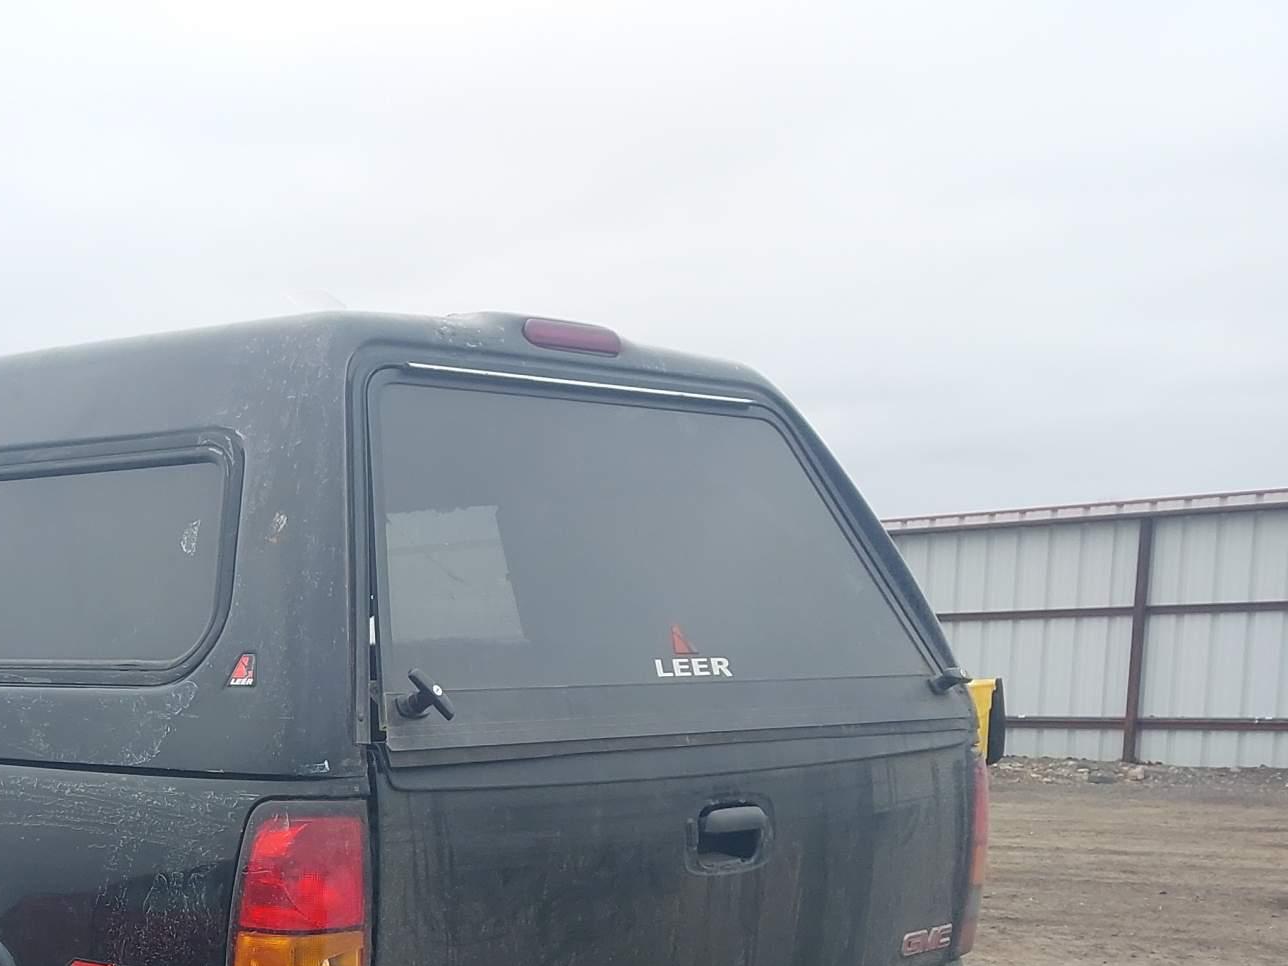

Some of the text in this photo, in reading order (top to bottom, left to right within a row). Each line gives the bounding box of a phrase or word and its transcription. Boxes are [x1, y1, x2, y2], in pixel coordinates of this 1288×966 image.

[654, 657, 733, 678] LEER
[230, 678, 254, 686] LEER
[902, 923, 953, 957] GMC
